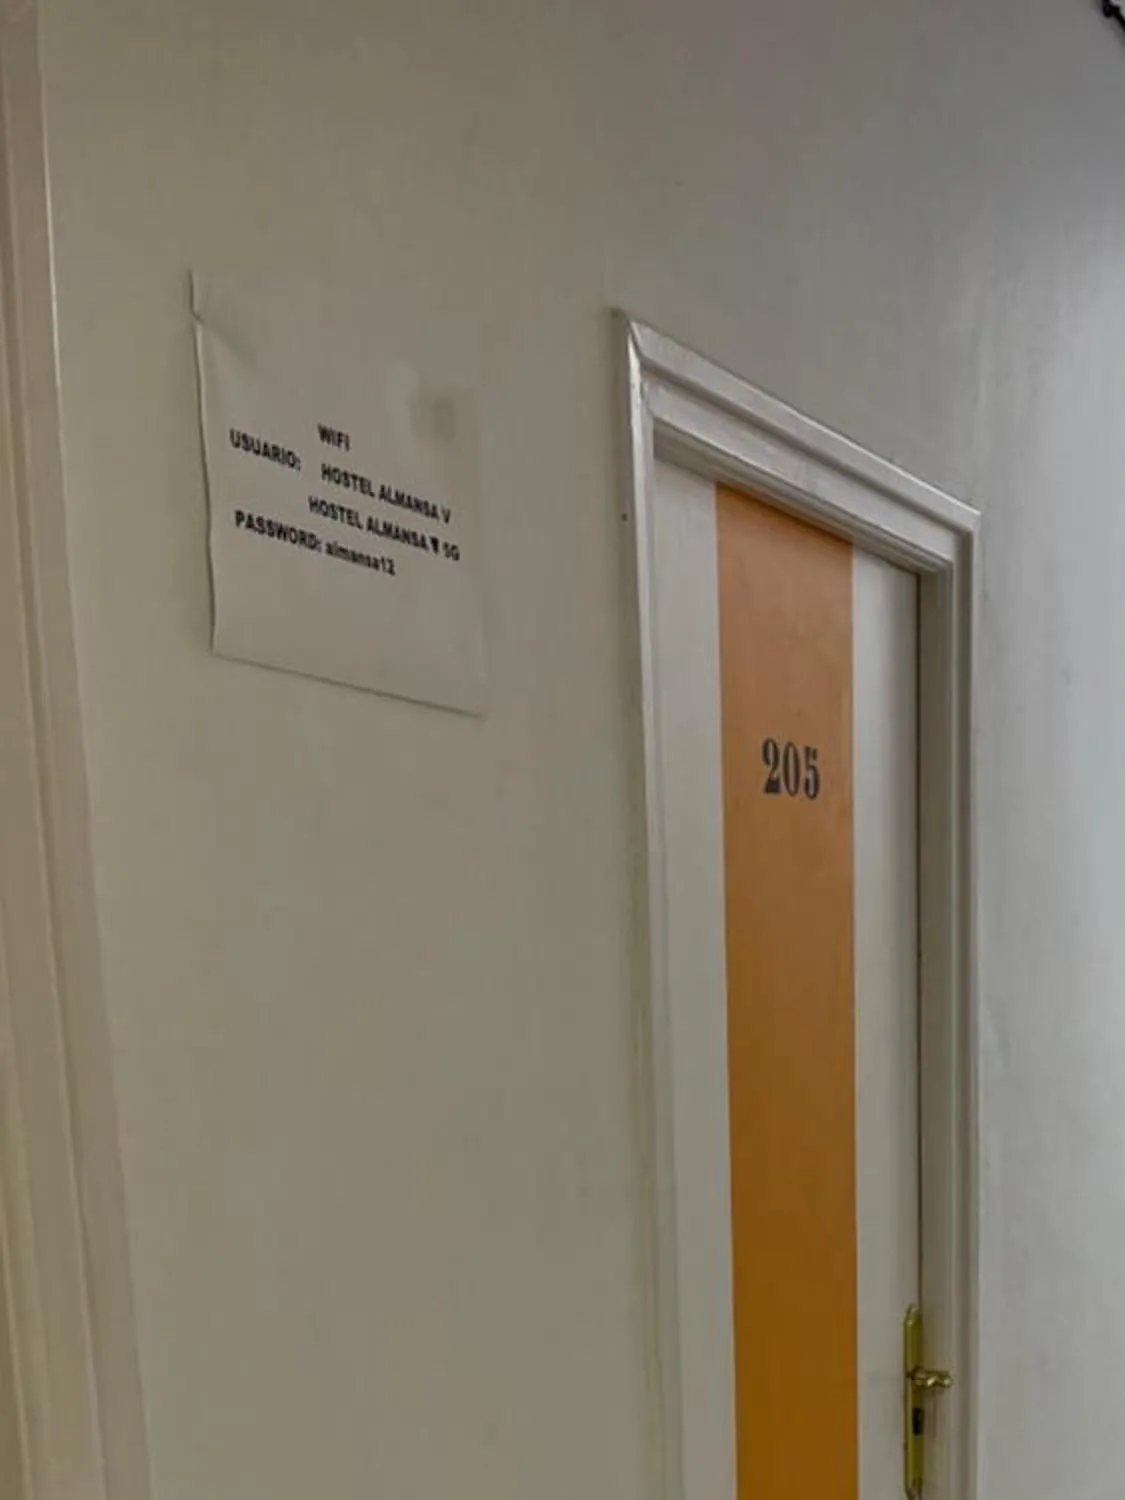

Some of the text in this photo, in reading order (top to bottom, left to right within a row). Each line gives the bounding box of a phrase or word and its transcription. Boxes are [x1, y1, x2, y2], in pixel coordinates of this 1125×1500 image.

[317, 422, 350, 452] WIFI
[229, 427, 451, 524] USUARIO: HOSTEL ALMANSA V
[235, 509, 322, 552] PASSWORD:
[307, 496, 363, 531] HOSTEL
[366, 515, 429, 552] ALMANSA
[762, 737, 820, 800] 205
